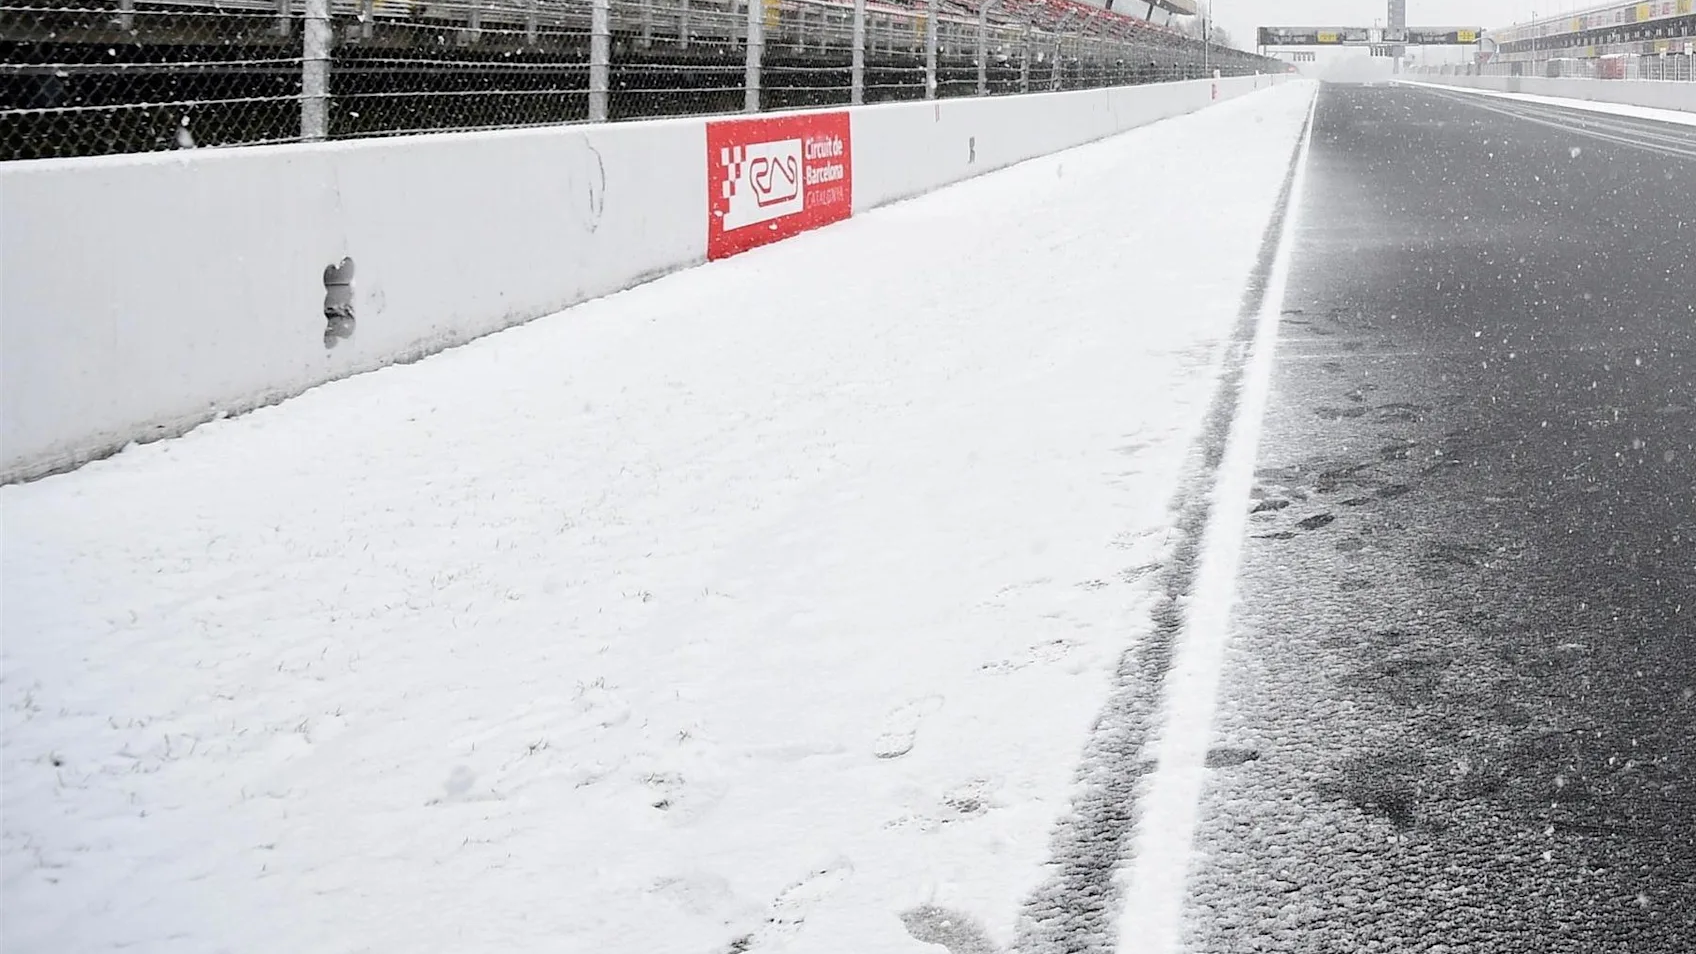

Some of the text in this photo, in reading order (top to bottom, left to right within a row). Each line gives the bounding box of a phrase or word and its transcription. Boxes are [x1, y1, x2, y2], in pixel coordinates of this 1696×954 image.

[805, 134, 843, 160] Circuit de
[806, 160, 844, 185] Barcelona
